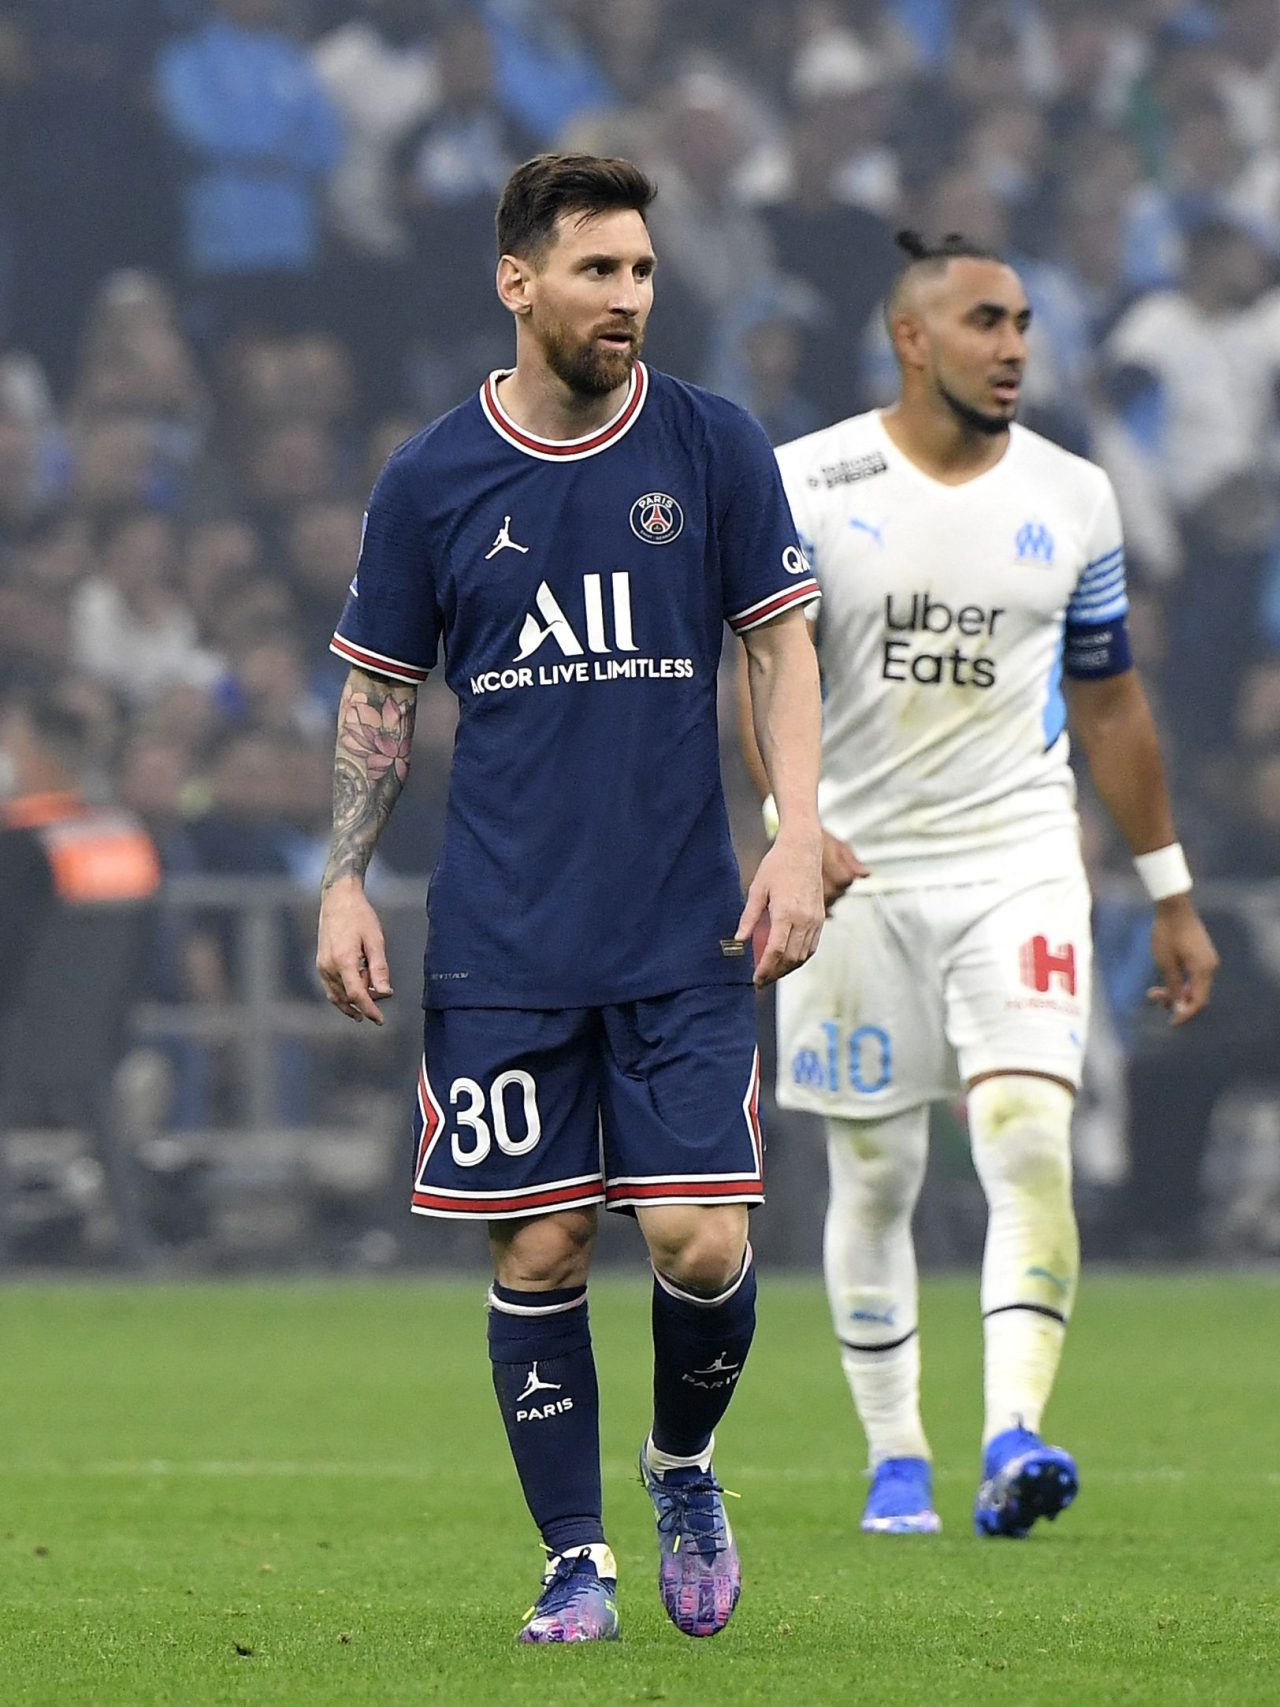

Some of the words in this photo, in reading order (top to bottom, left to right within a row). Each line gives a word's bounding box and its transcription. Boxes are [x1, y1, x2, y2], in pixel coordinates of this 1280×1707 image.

[638, 495, 674, 509] PARIS
[886, 593, 1005, 635] Uber
[470, 667, 534, 695] ACCOR
[539, 662, 589, 686] LIVE
[594, 658, 694, 681] LIMITLESS
[882, 640, 995, 688] Eats
[822, 1022, 892, 1093] 10
[449, 1069, 541, 1167] 30
[516, 1397, 574, 1422] PARIS
